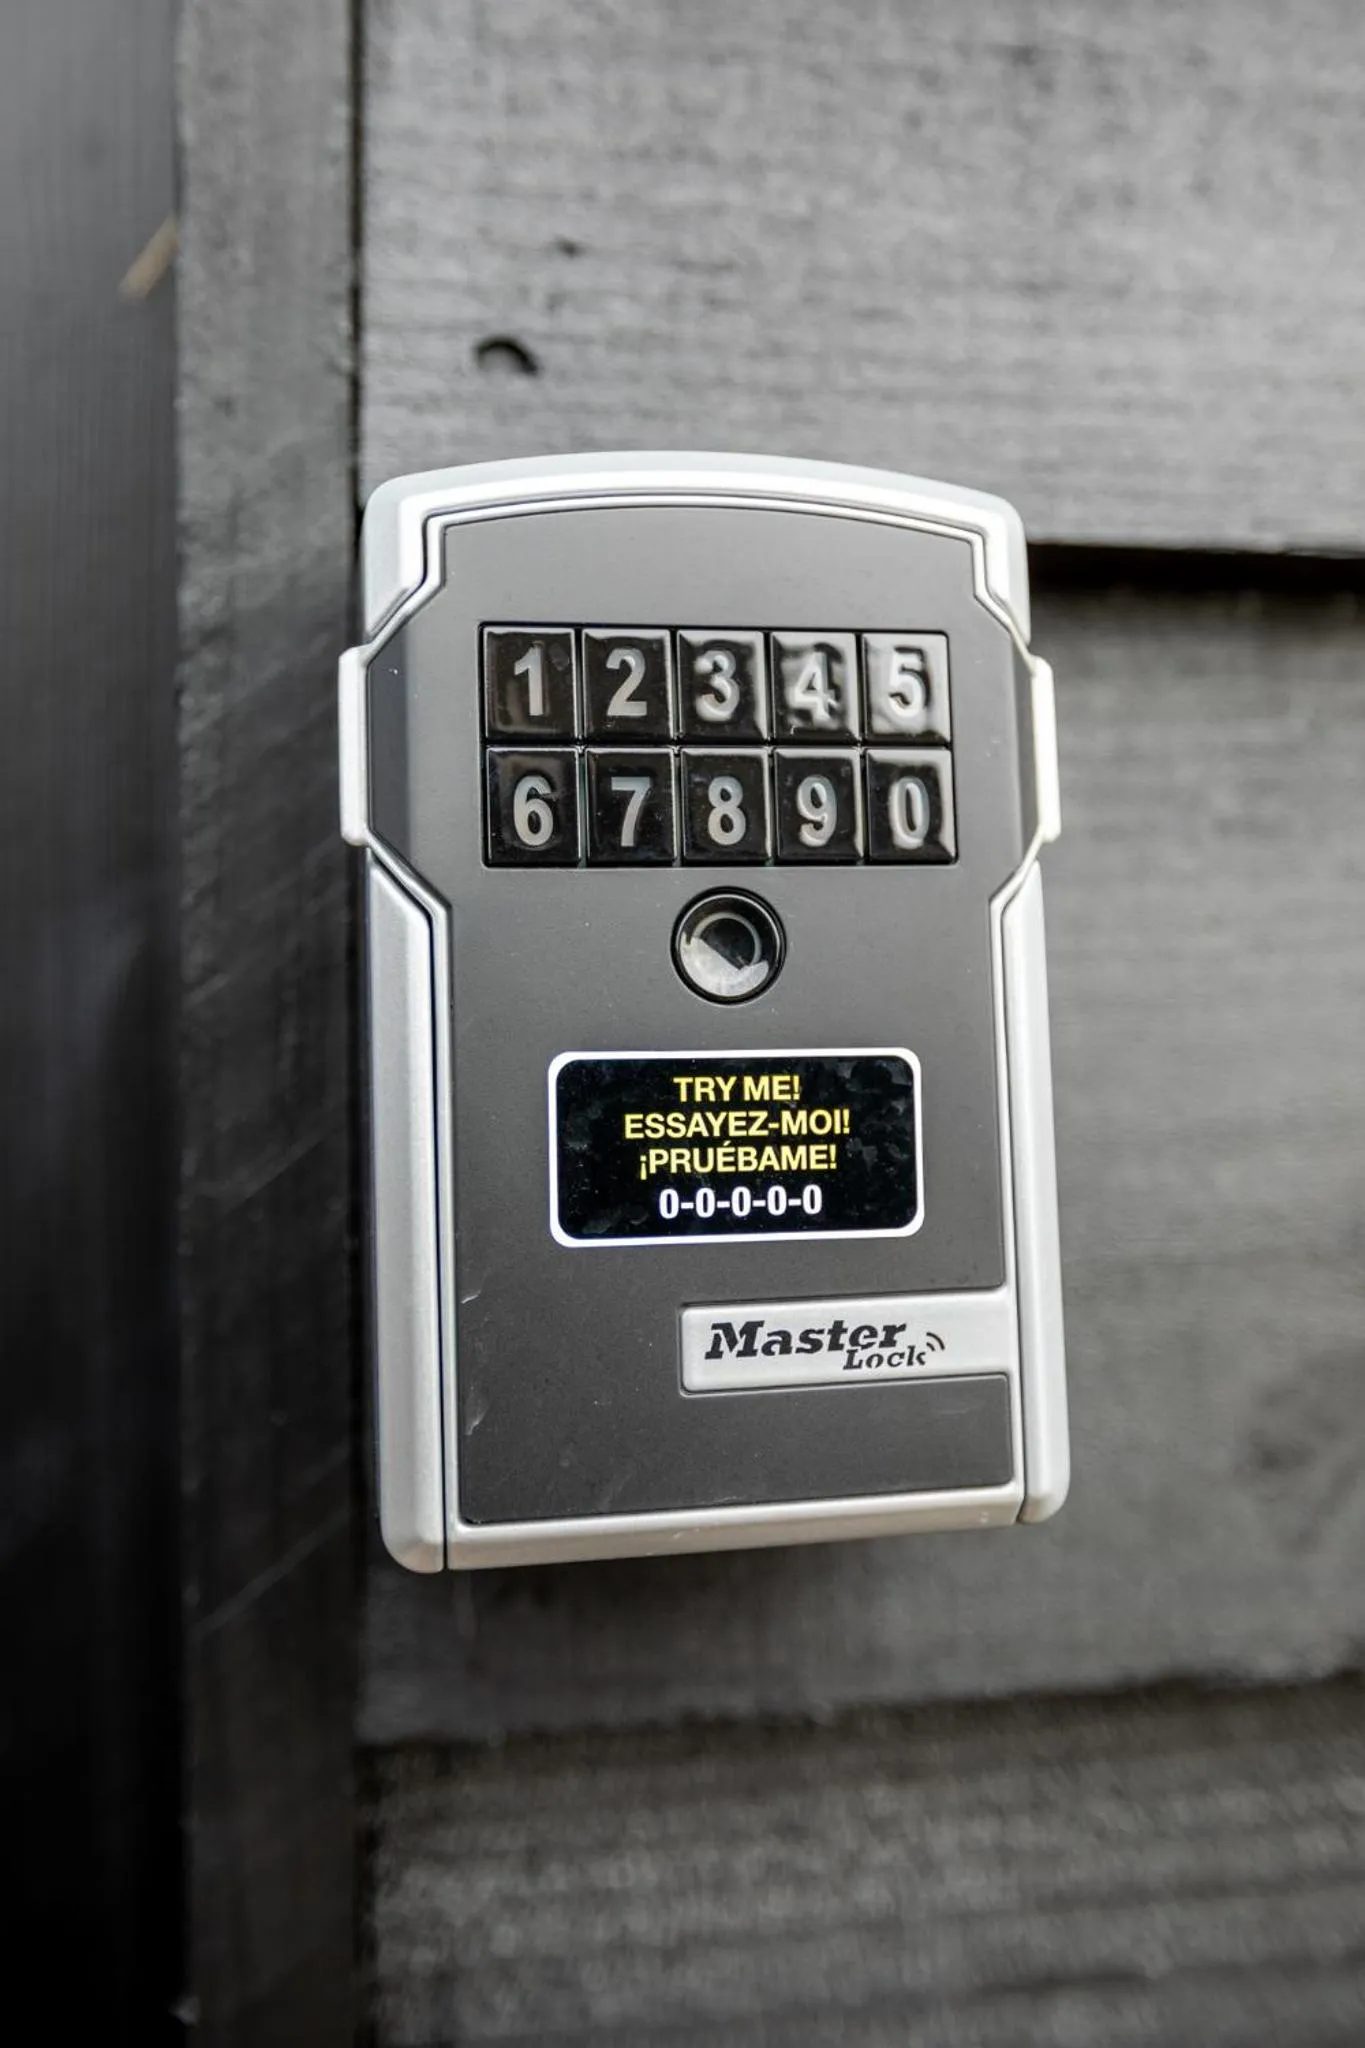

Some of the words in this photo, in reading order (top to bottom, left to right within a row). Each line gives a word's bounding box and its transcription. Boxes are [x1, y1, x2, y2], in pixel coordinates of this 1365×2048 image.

[514, 646, 544, 717] 1
[606, 648, 648, 717] 2
[696, 649, 741, 722] 3
[794, 650, 836, 722] 4
[890, 648, 926, 719] 5
[513, 775, 555, 847] 6
[611, 776, 651, 847] 7
[707, 776, 746, 846] 8
[798, 775, 837, 847] 9
[889, 776, 930, 849] 0
[673, 1076, 736, 1103] TRY
[743, 1075, 800, 1101] ME!
[624, 1109, 850, 1140] ESSAYEZ-MOI!
[639, 1141, 837, 1180] ¡PRUÉBAME!
[659, 1184, 823, 1219] 0-0-0-0-0
[704, 1320, 907, 1360] Master
[843, 1345, 926, 1370] Lock
